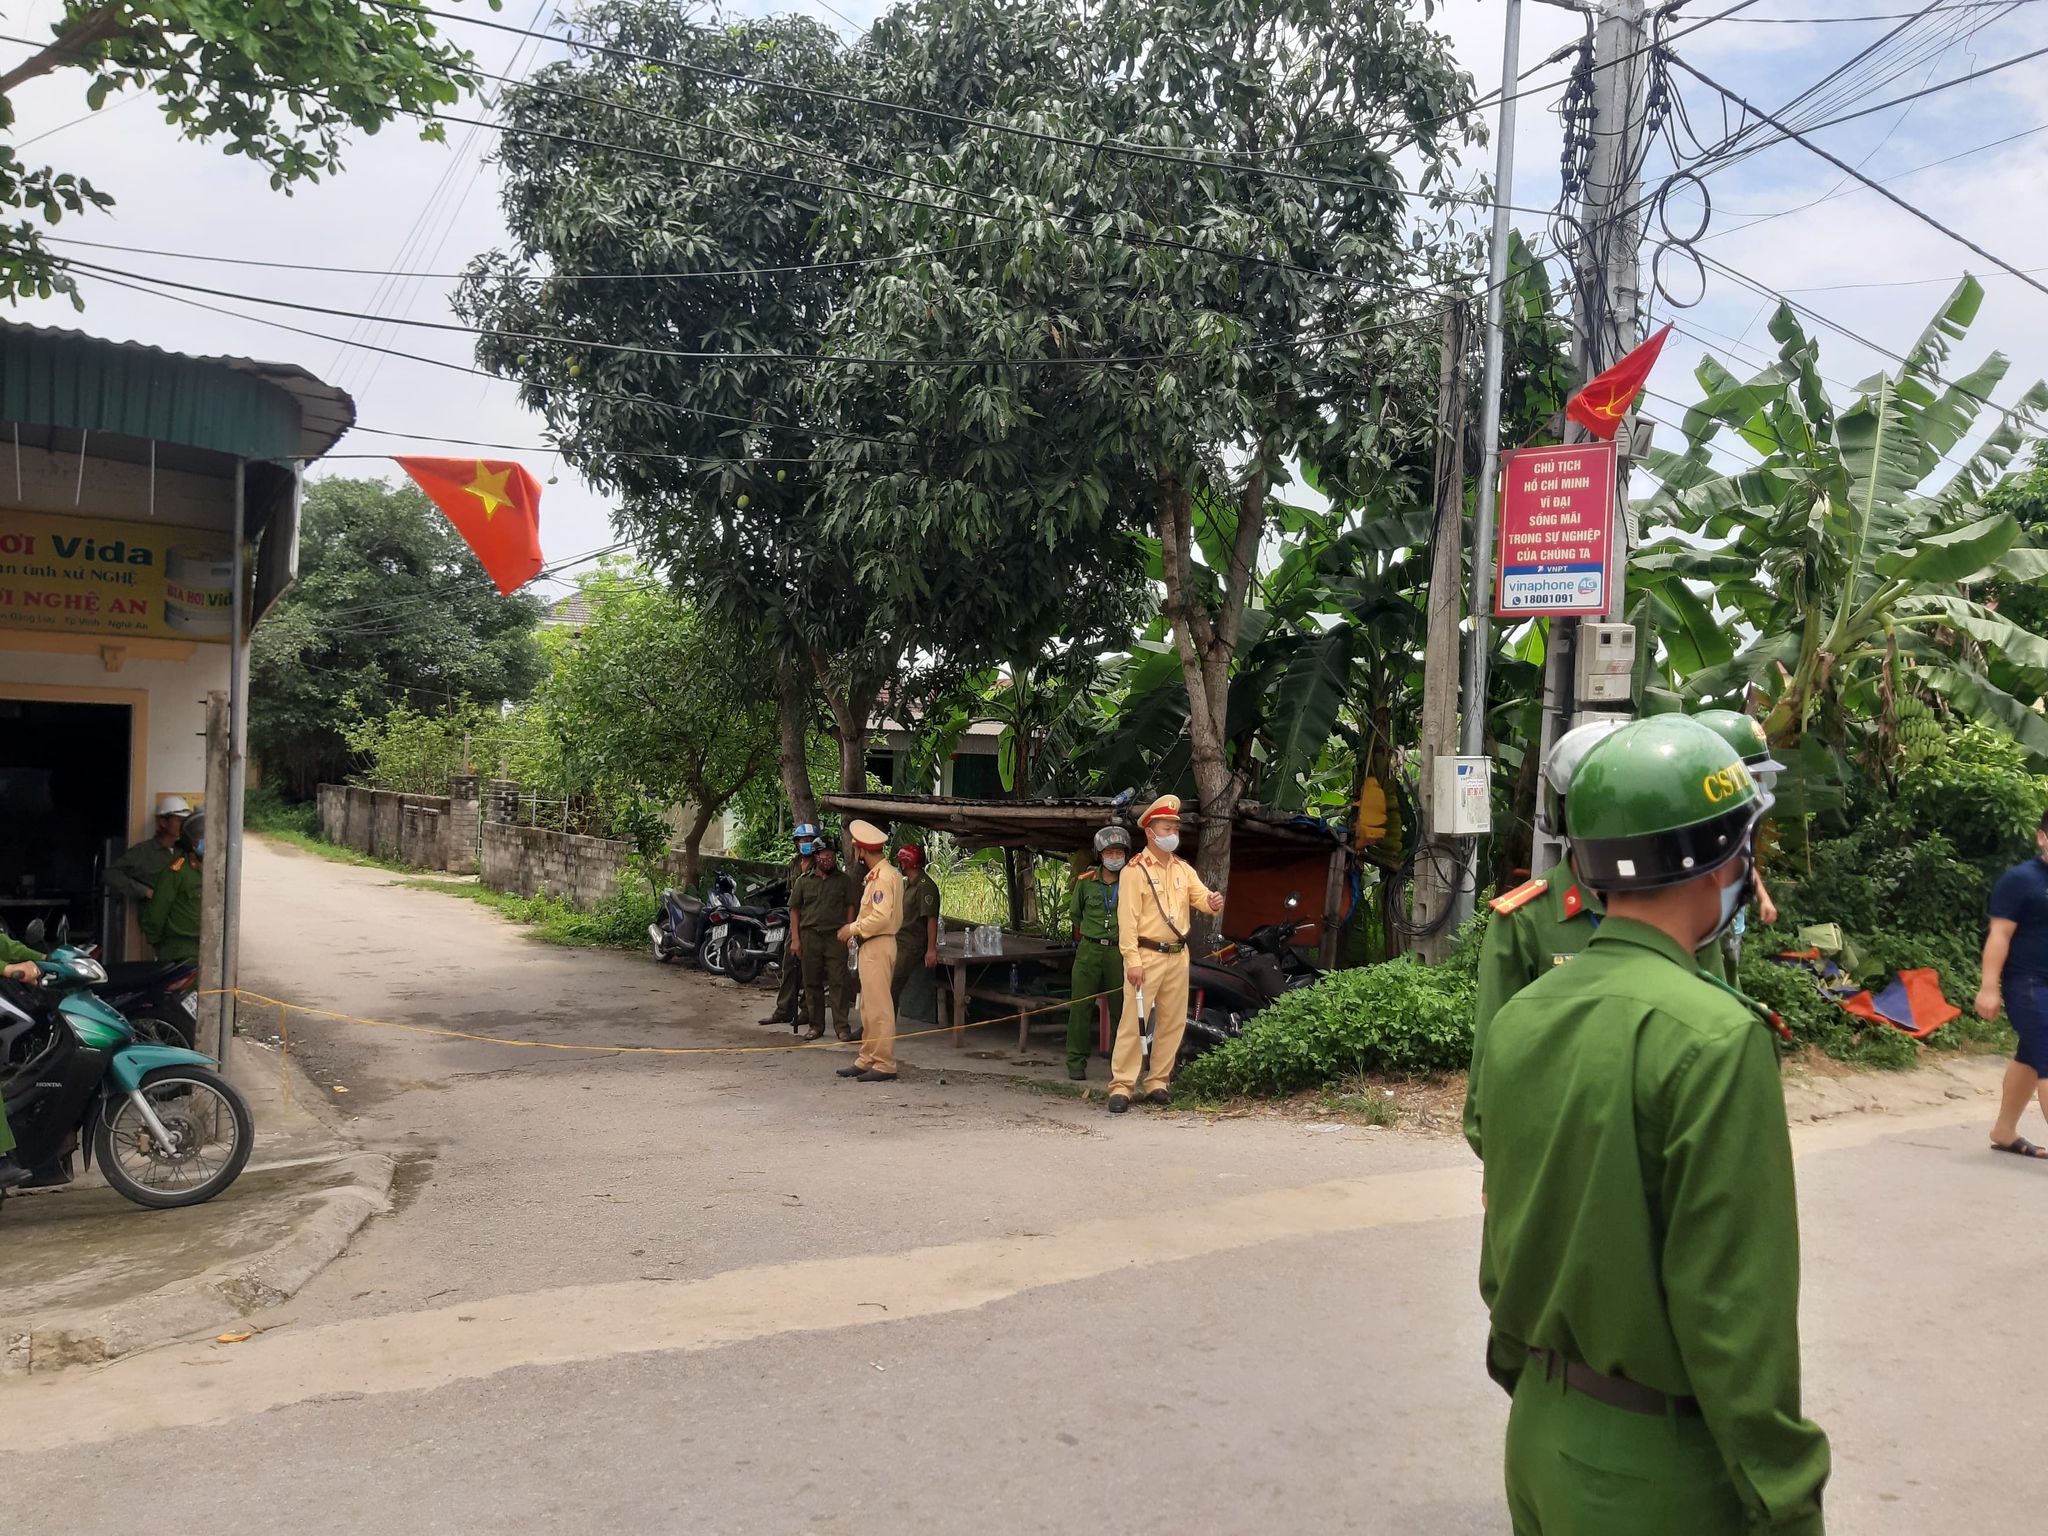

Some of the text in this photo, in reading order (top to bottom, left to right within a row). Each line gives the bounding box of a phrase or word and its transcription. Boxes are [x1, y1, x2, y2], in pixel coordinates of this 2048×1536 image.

[1534, 458, 1581, 474] CHỦ TỊCH
[1541, 477, 1558, 491] CHÍ
[1561, 477, 1589, 490] MINH
[1540, 495, 1571, 509] VĨ ĐẠI
[1529, 511, 1581, 526] SỐNG MÃI
[1509, 529, 1601, 546] TRONG SỰ NGHIỆP
[51, 534, 153, 566] Vida
[1517, 546, 1591, 562] CỦA CHÚNG TA
[1547, 565, 1568, 573] VNPT
[90, 568, 137, 588] NGHỆ
[1509, 579, 1574, 593] vinaphone
[1580, 579, 1594, 588] 4G
[24, 590, 100, 615] NGHỆ
[108, 598, 148, 615] AN
[1524, 593, 1573, 604] 18001091
[35, 1080, 63, 1088] HONDA
